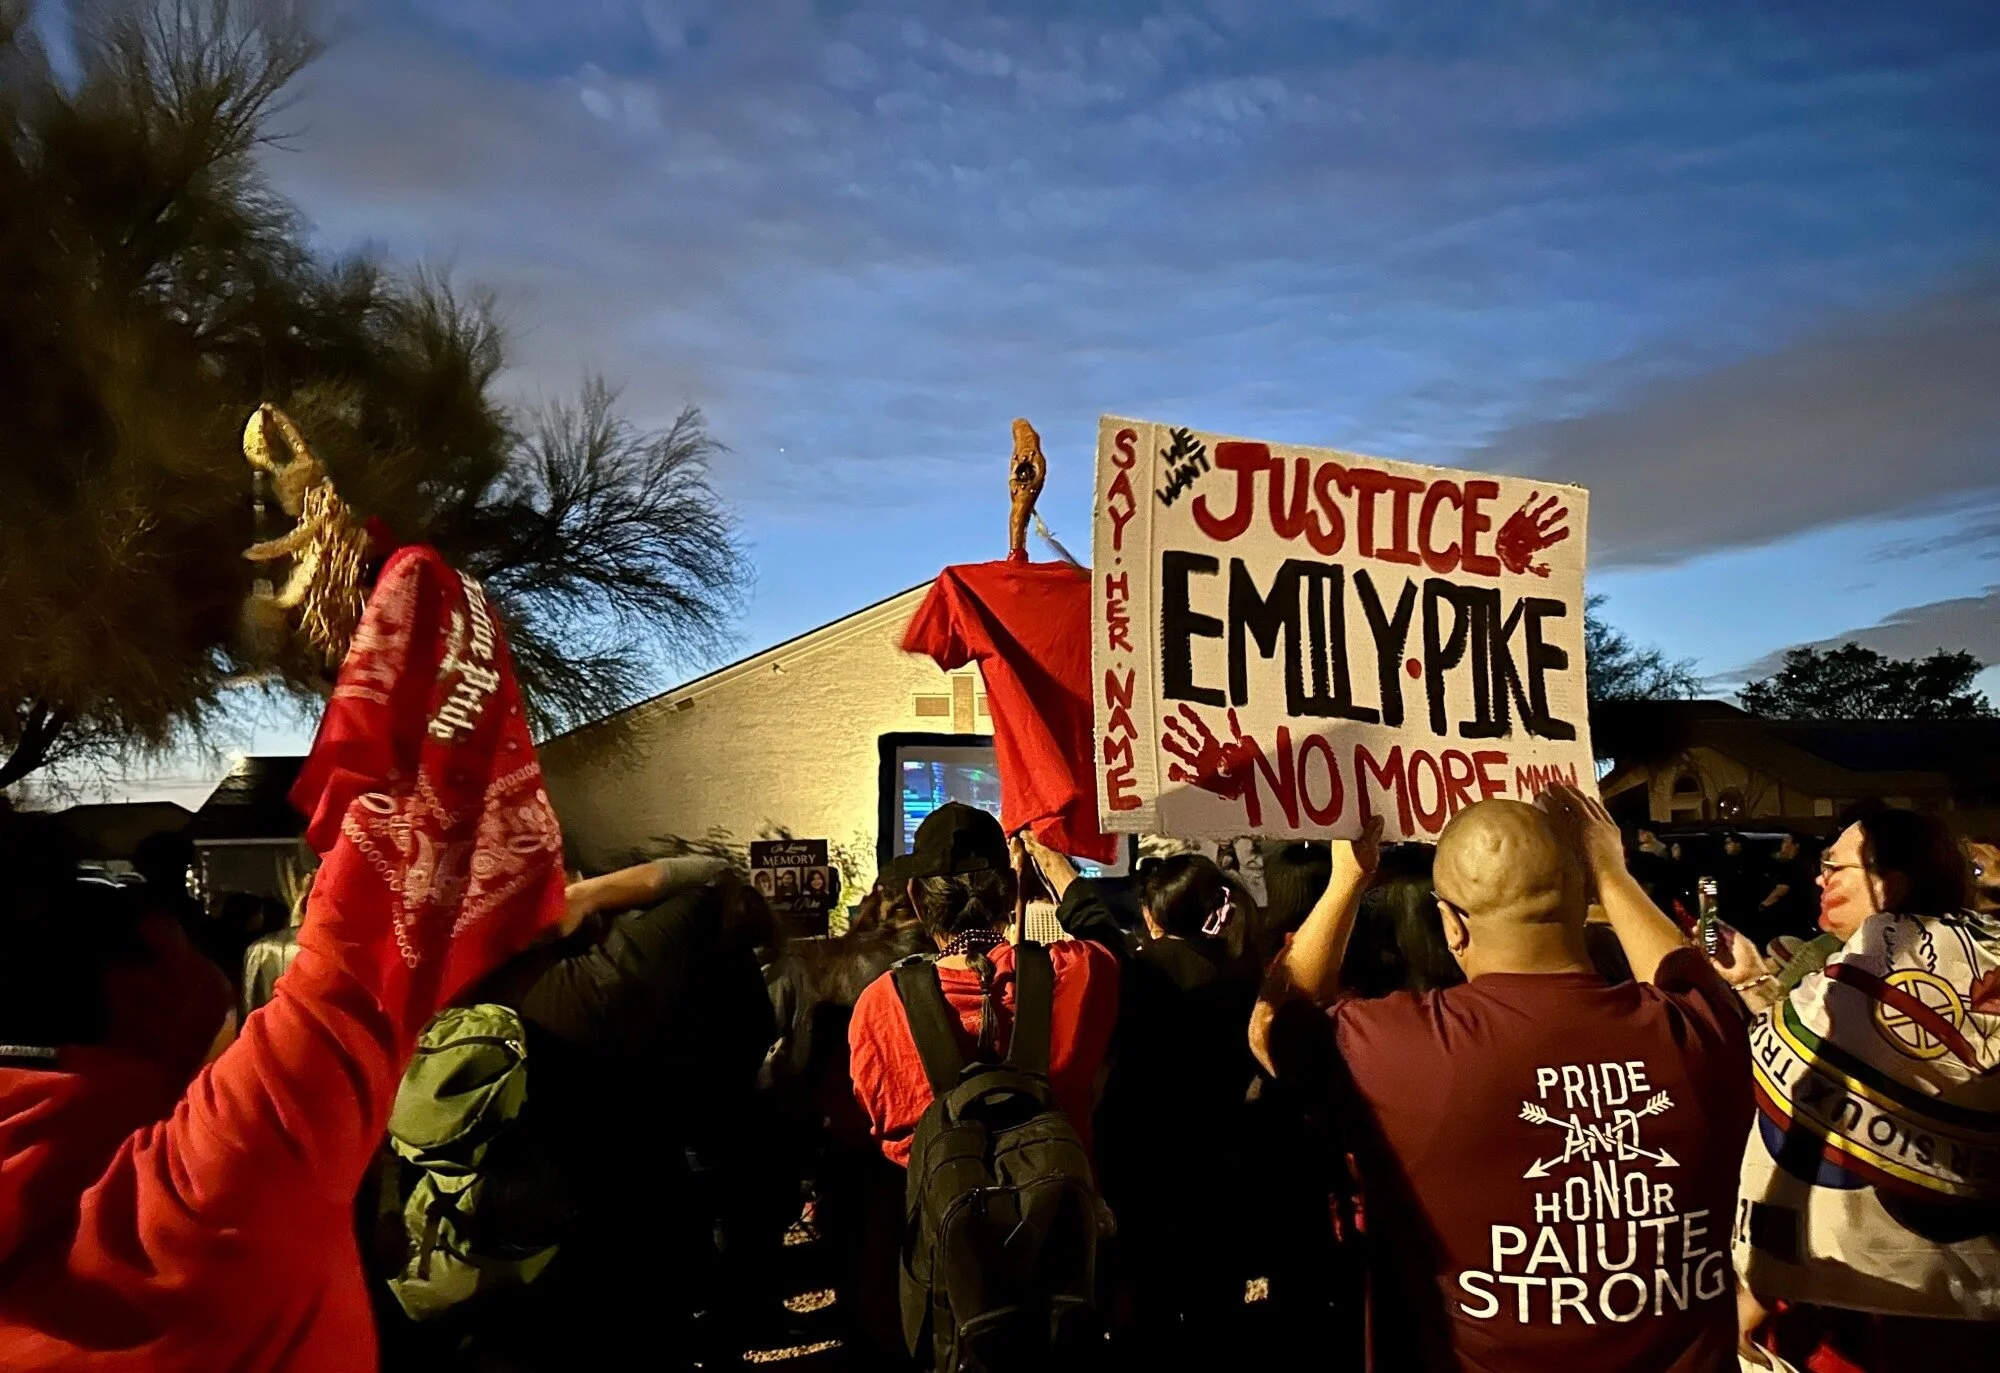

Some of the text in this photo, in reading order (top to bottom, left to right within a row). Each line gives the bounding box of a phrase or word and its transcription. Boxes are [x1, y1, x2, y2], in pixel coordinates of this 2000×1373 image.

[1155, 445, 1211, 507] WANT
[1160, 427, 1200, 467] WE
[1192, 441, 1502, 577] JUSTICE
[1422, 578, 1577, 741] PIKE
[428, 660, 502, 739] Pride
[1103, 667, 1142, 812] NAME
[1240, 725, 1343, 829] NO
[1354, 744, 1509, 837] MORE
[762, 854, 816, 867] MEMORY
[1750, 1013, 1793, 1087] TRI
[1536, 1060, 1651, 1118] PRIDE
[1563, 1109, 1640, 1163] AND
[1799, 1087, 1936, 1166] SIOUX
[1534, 1160, 1675, 1223] HONOR
[1491, 1209, 1710, 1275] PAIUTE
[1458, 1251, 1726, 1325] STRONG
